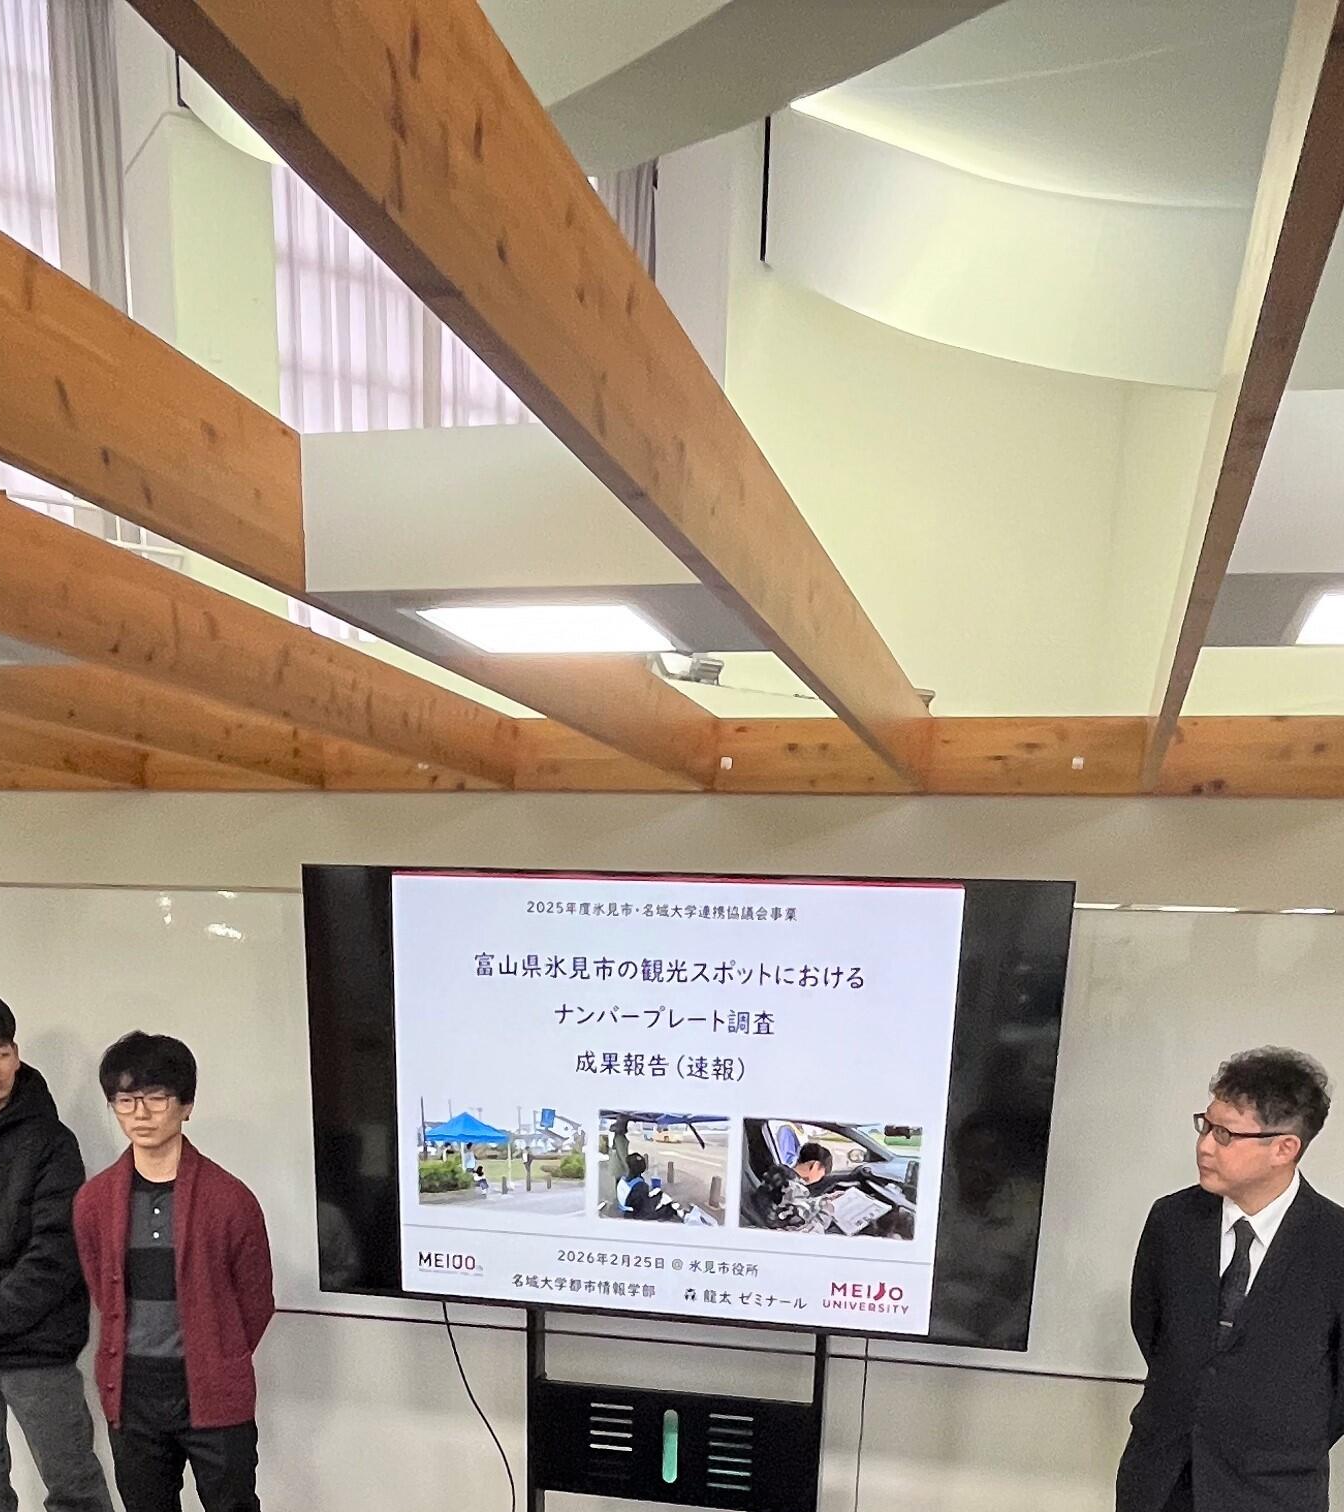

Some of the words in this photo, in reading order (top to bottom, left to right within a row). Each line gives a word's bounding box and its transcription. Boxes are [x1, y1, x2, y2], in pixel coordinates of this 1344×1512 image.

[474, 951, 865, 989] 富山県氷見市の観光スポットにおける
[554, 1003, 775, 1035] ナンバープレート調査
[557, 1249, 665, 1270] 2026年2月25日
[671, 1258, 684, 1271] @
[688, 1259, 759, 1278] 氷見市役所
[512, 1273, 656, 1298] 名城大学都市情報学部
[738, 1291, 808, 1310] ゼミナール
[822, 1298, 909, 1315] UNIVERSITY
